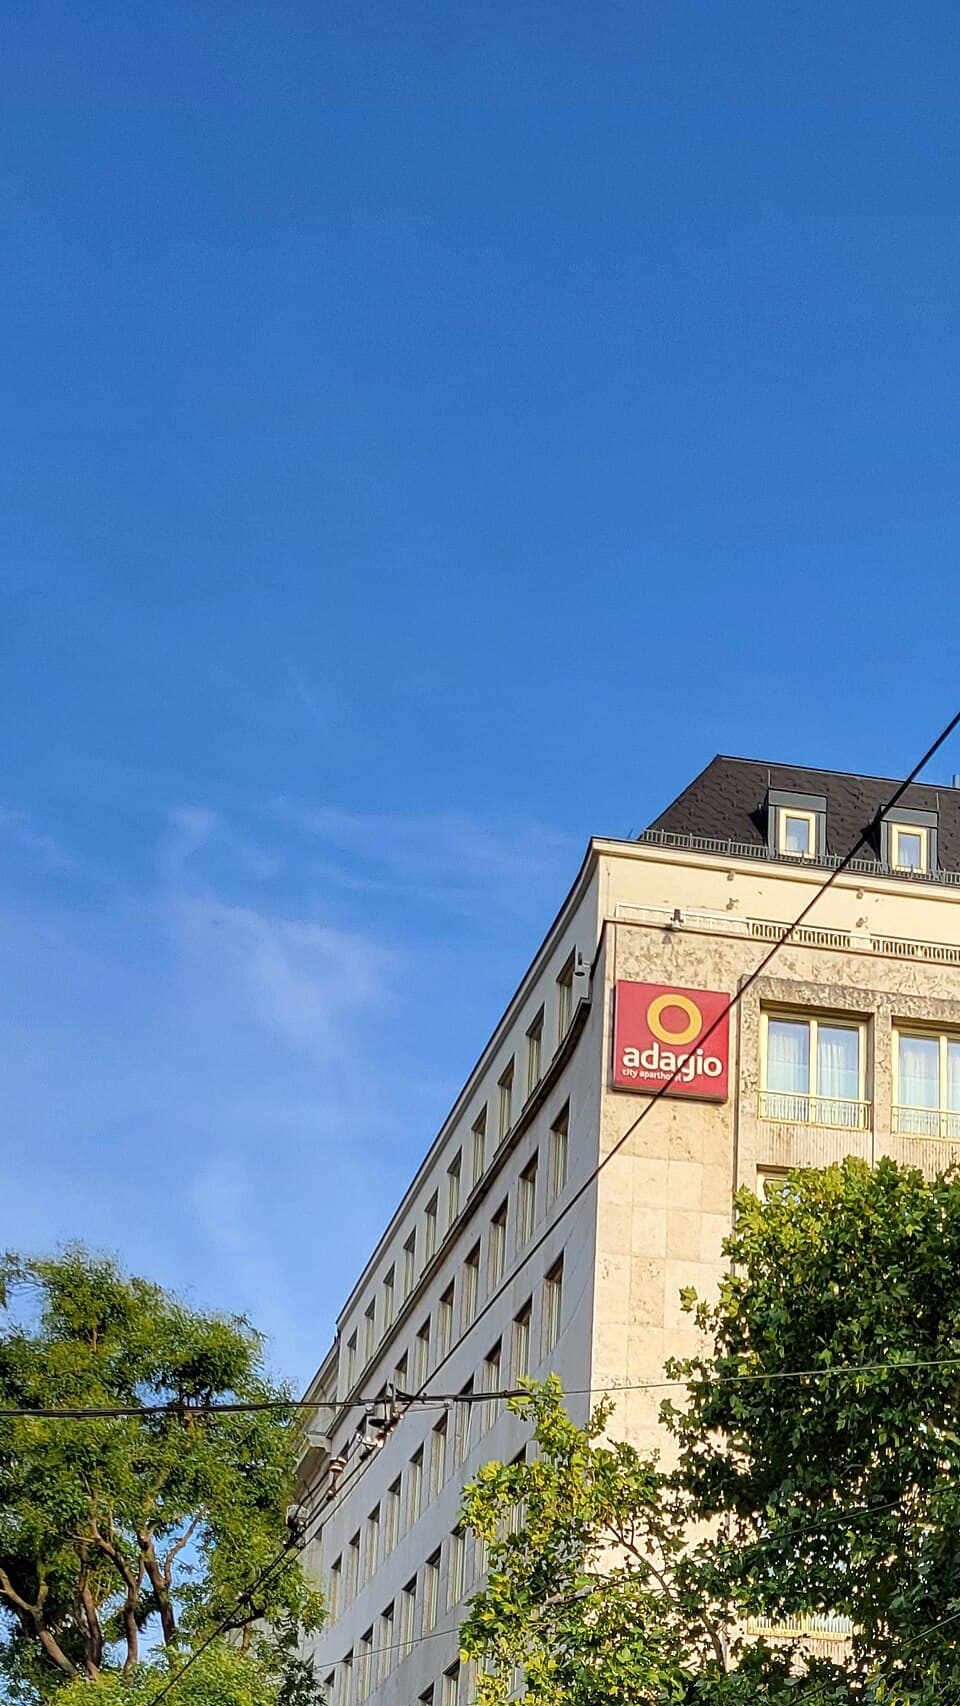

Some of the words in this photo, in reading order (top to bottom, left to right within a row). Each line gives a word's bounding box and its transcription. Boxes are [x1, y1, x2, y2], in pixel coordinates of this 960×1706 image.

[622, 1042, 723, 1082] adagio
[622, 1067, 638, 1079] city
[640, 1069, 682, 1082] aparthol
